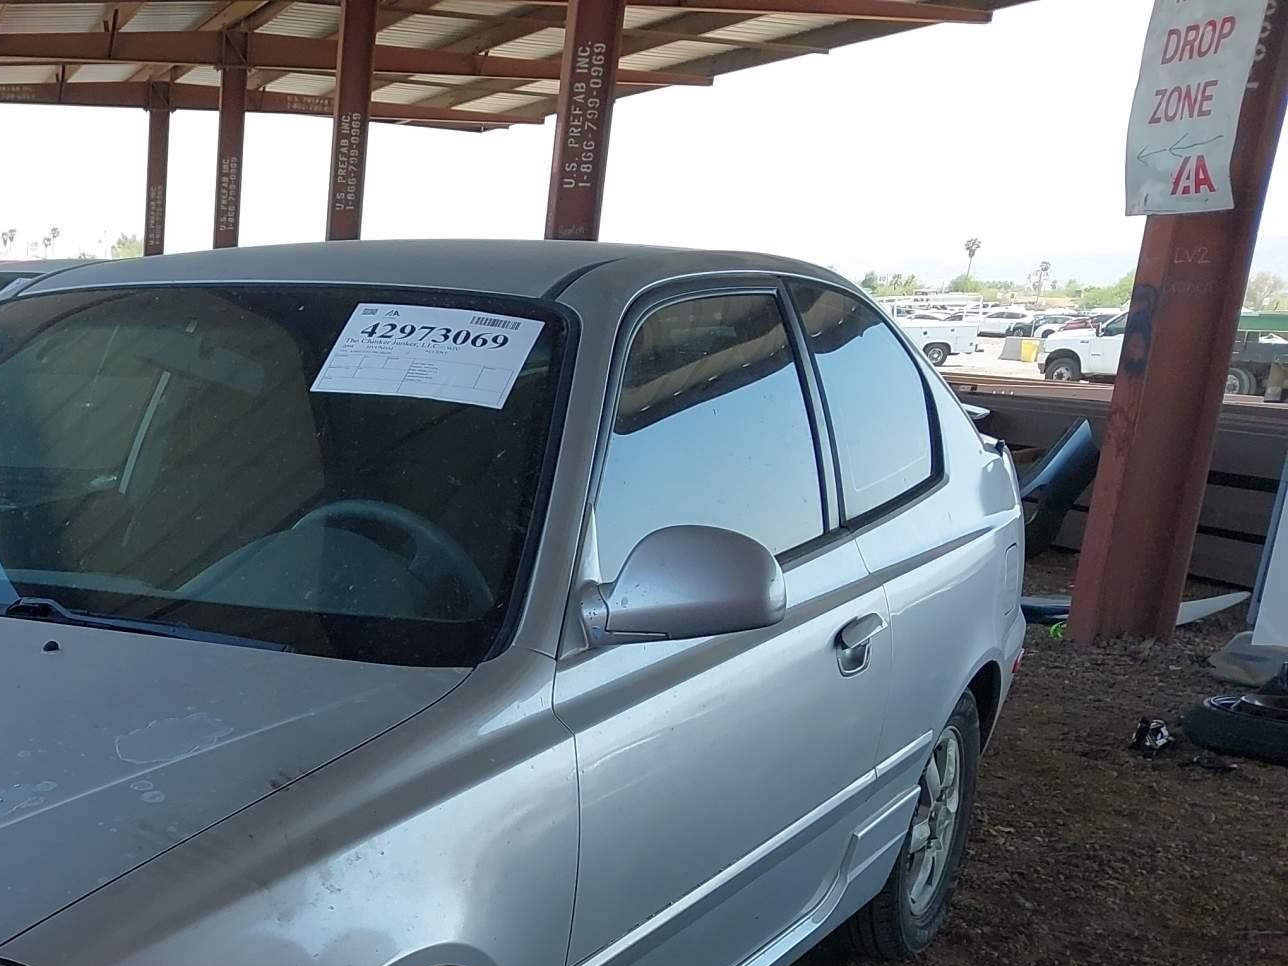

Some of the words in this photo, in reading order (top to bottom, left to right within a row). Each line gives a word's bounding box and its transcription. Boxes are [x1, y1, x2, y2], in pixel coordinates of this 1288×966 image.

[576, 40, 593, 73] INC.
[1161, 16, 1236, 64] DROP
[567, 82, 586, 148] PREFAB
[1148, 80, 1219, 124] ZONE
[338, 136, 349, 184] PREFAB
[563, 156, 579, 188] U.S.
[1174, 247, 1211, 264] LV2
[361, 322, 509, 349] 42973069
